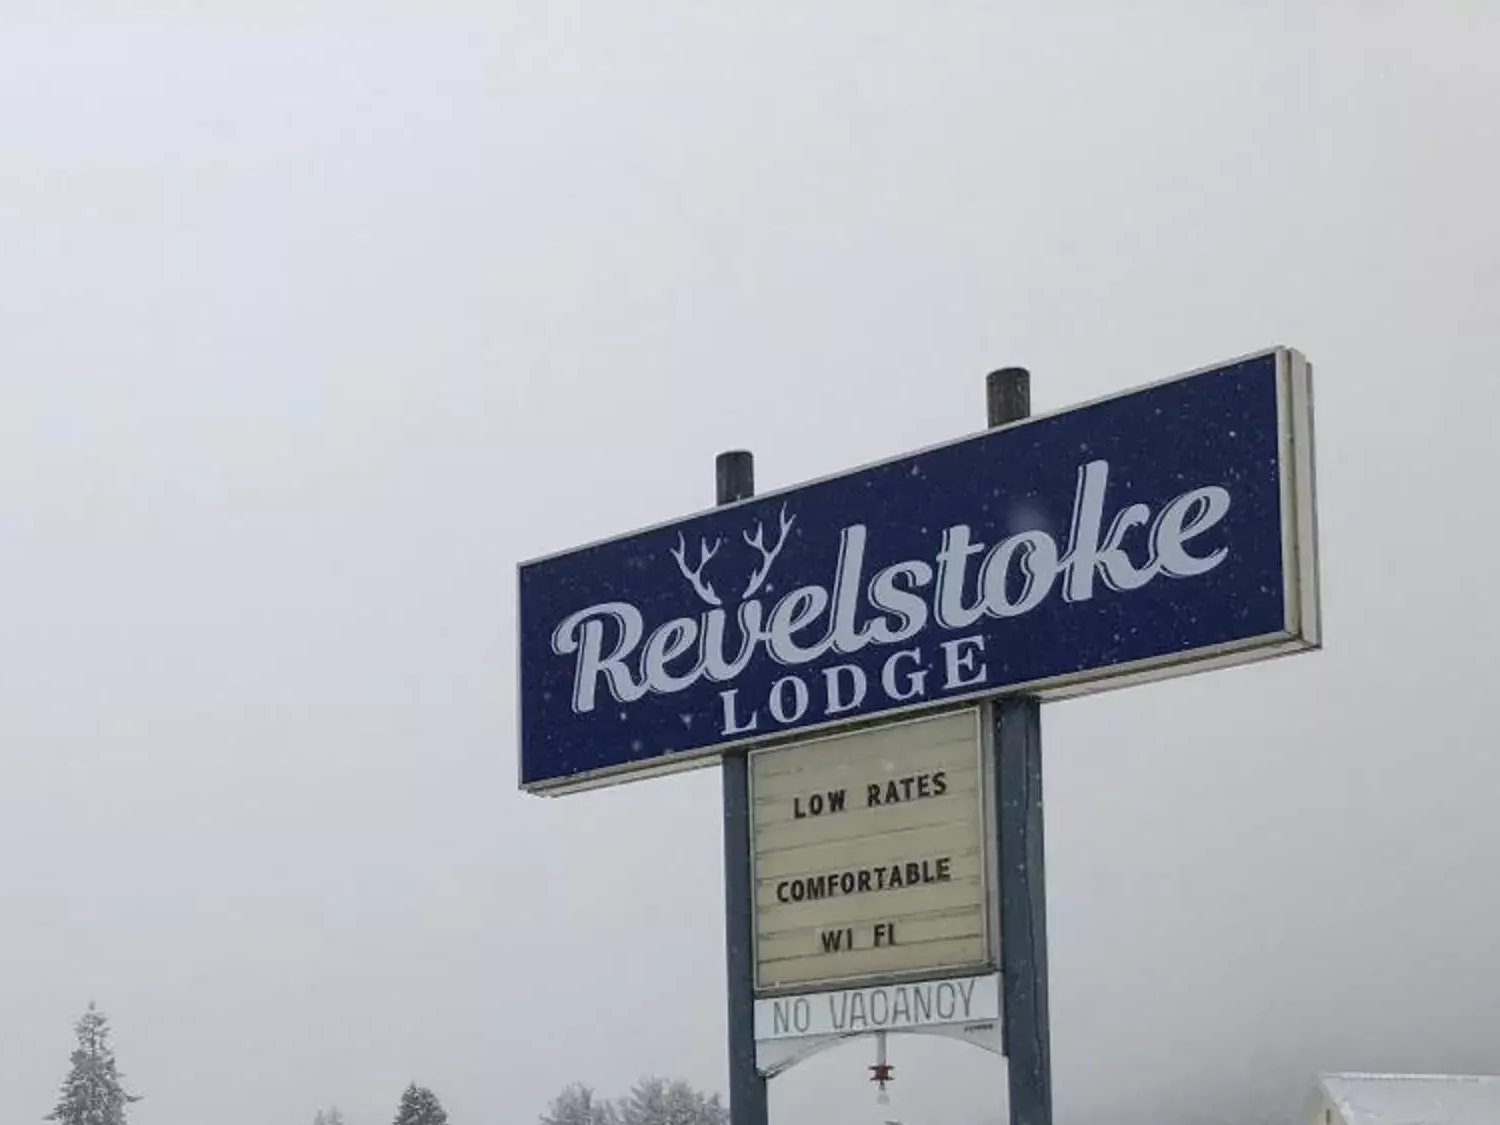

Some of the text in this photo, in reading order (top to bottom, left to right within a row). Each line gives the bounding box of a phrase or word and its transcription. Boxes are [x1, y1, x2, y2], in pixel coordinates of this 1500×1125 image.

[552, 460, 1232, 715] Revelstoke
[720, 634, 988, 736] LODGE
[793, 772, 948, 819] LOW RATES
[776, 857, 952, 903] COMFORTABLE
[821, 923, 896, 953] WI FI
[773, 997, 810, 1034] NO
